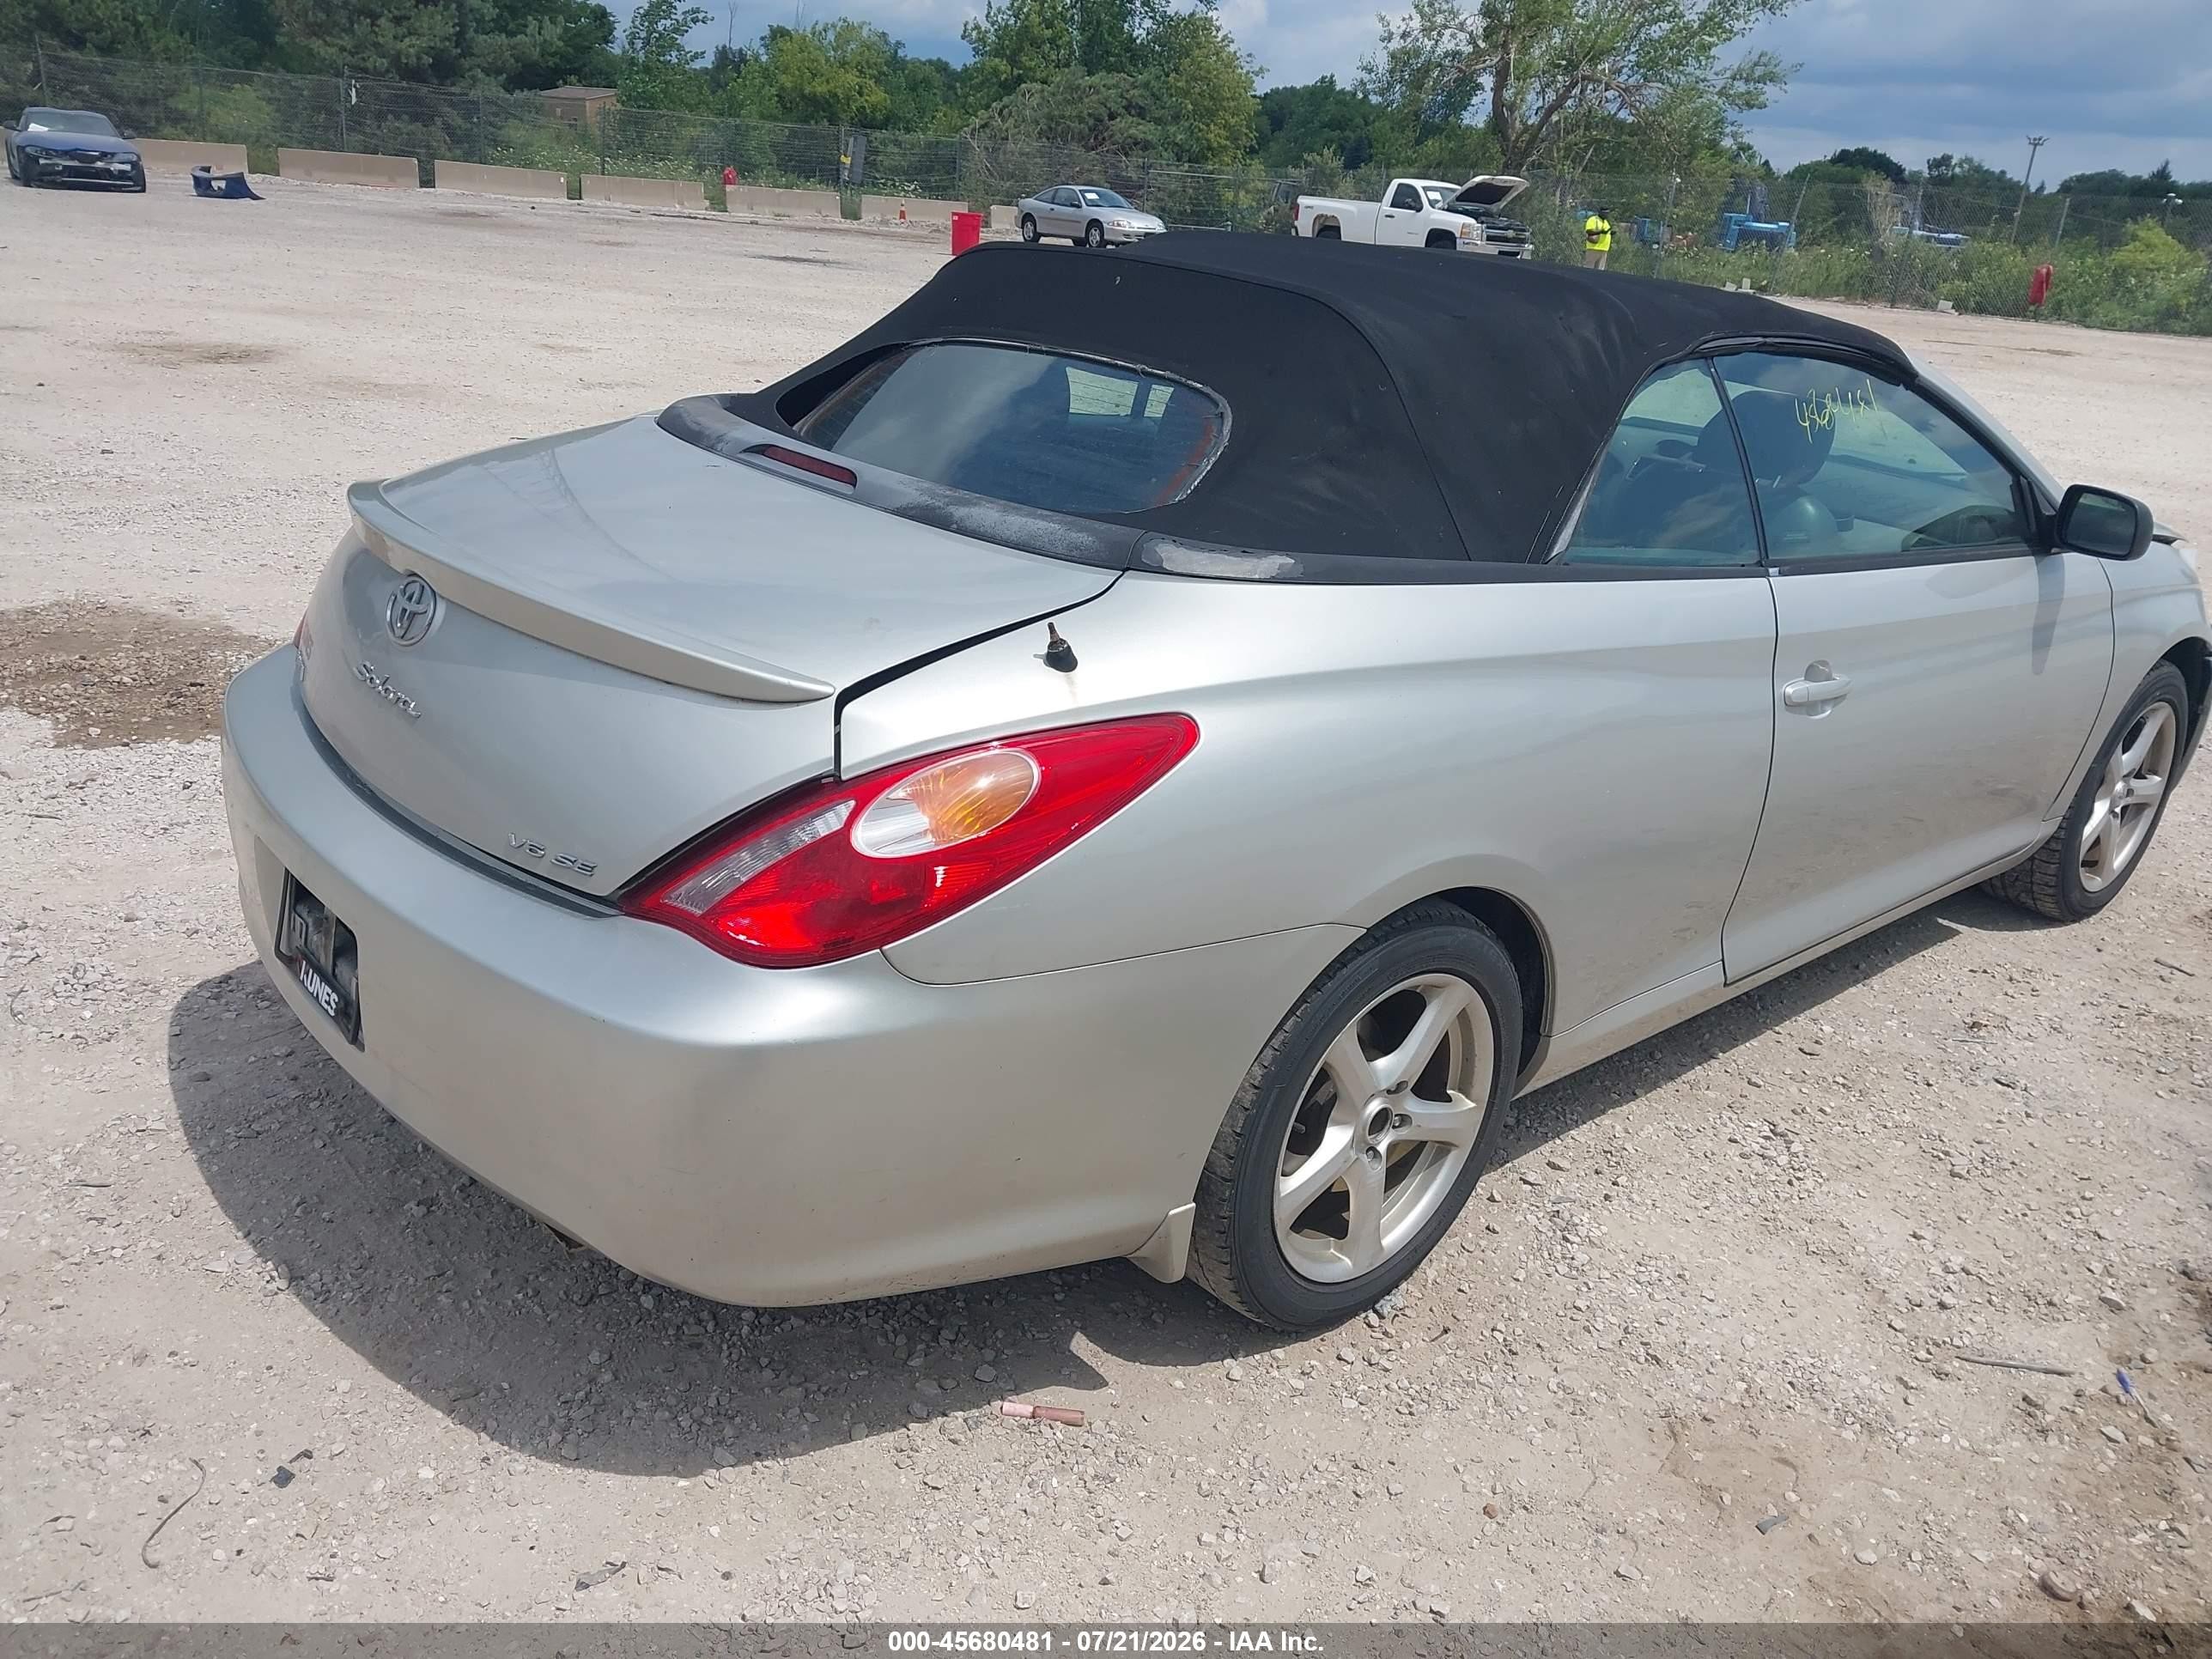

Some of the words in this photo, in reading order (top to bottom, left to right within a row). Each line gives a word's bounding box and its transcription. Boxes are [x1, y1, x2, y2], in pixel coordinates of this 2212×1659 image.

[353, 660, 421, 718] Solara
[507, 832, 545, 858] V6
[550, 853, 598, 877] SE
